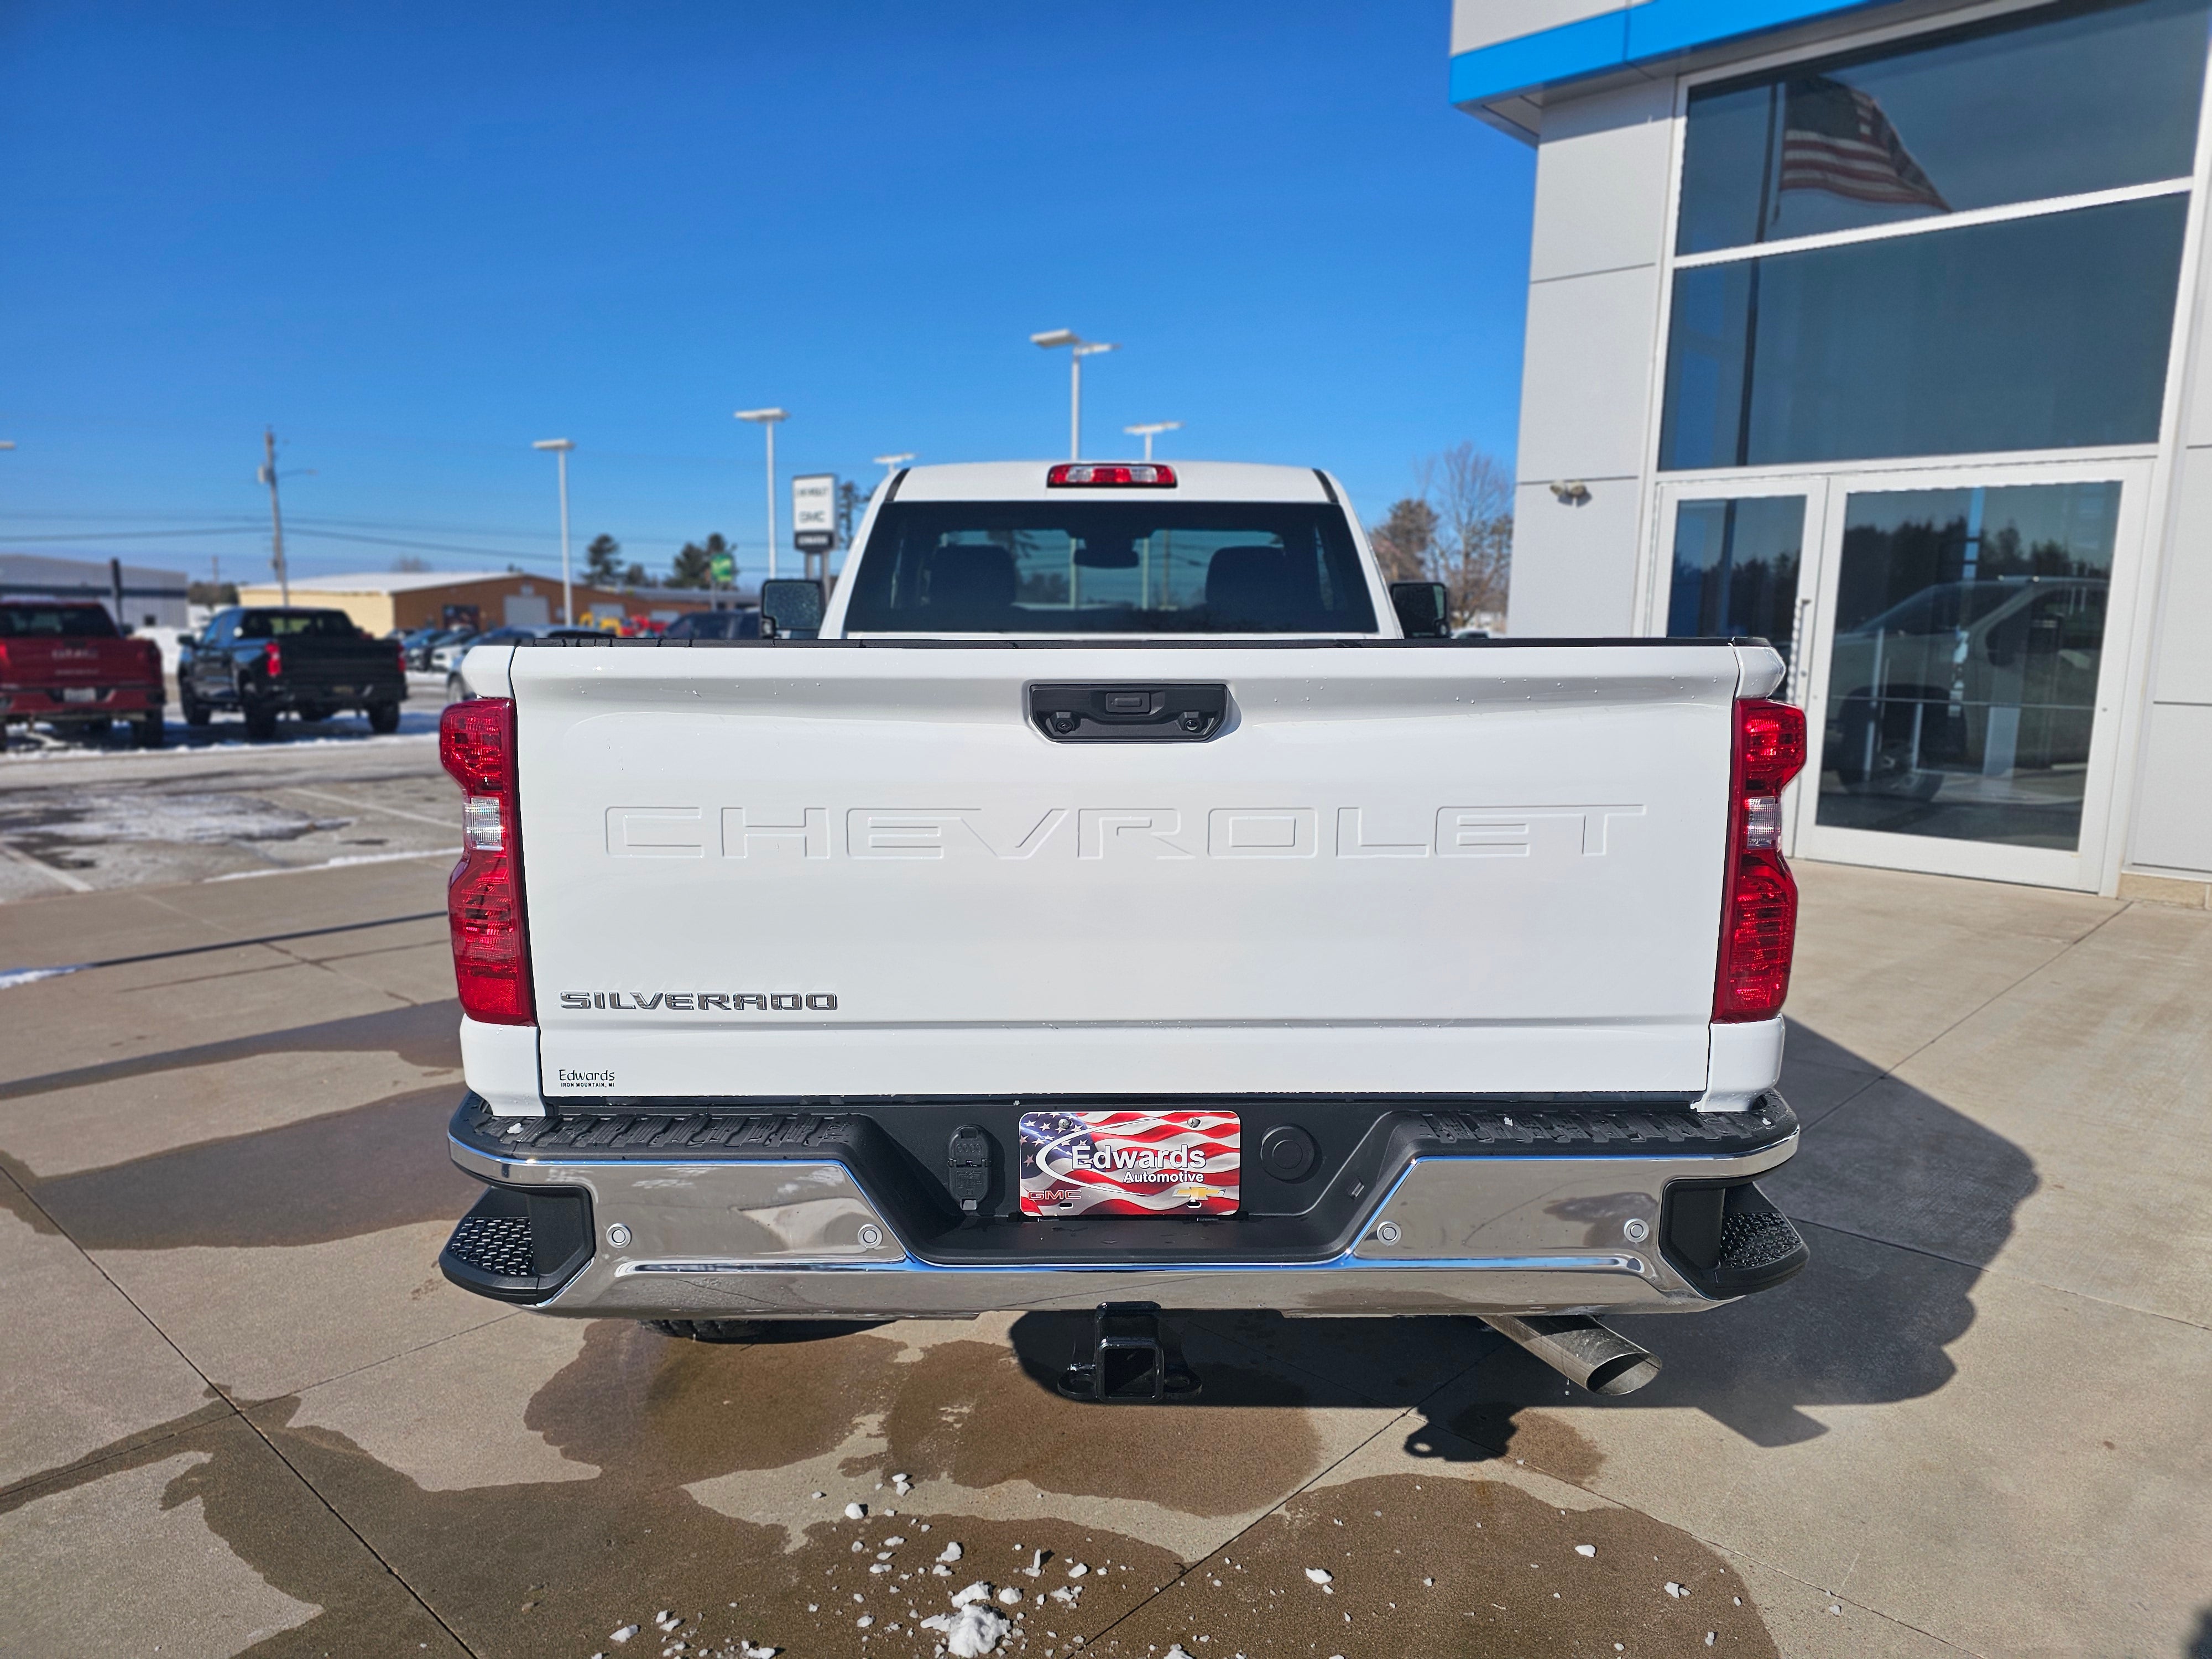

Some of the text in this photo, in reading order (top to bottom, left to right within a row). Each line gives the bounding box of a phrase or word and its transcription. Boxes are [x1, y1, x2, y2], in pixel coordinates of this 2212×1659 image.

[605, 804, 1647, 860] CHEVROLET
[560, 990, 838, 1011] SILVERADO
[559, 1069, 615, 1081] Edwards
[1071, 1144, 1206, 1170] Edwards
[1123, 1171, 1204, 1183] Automotive
[1027, 1190, 1082, 1201] GMC
